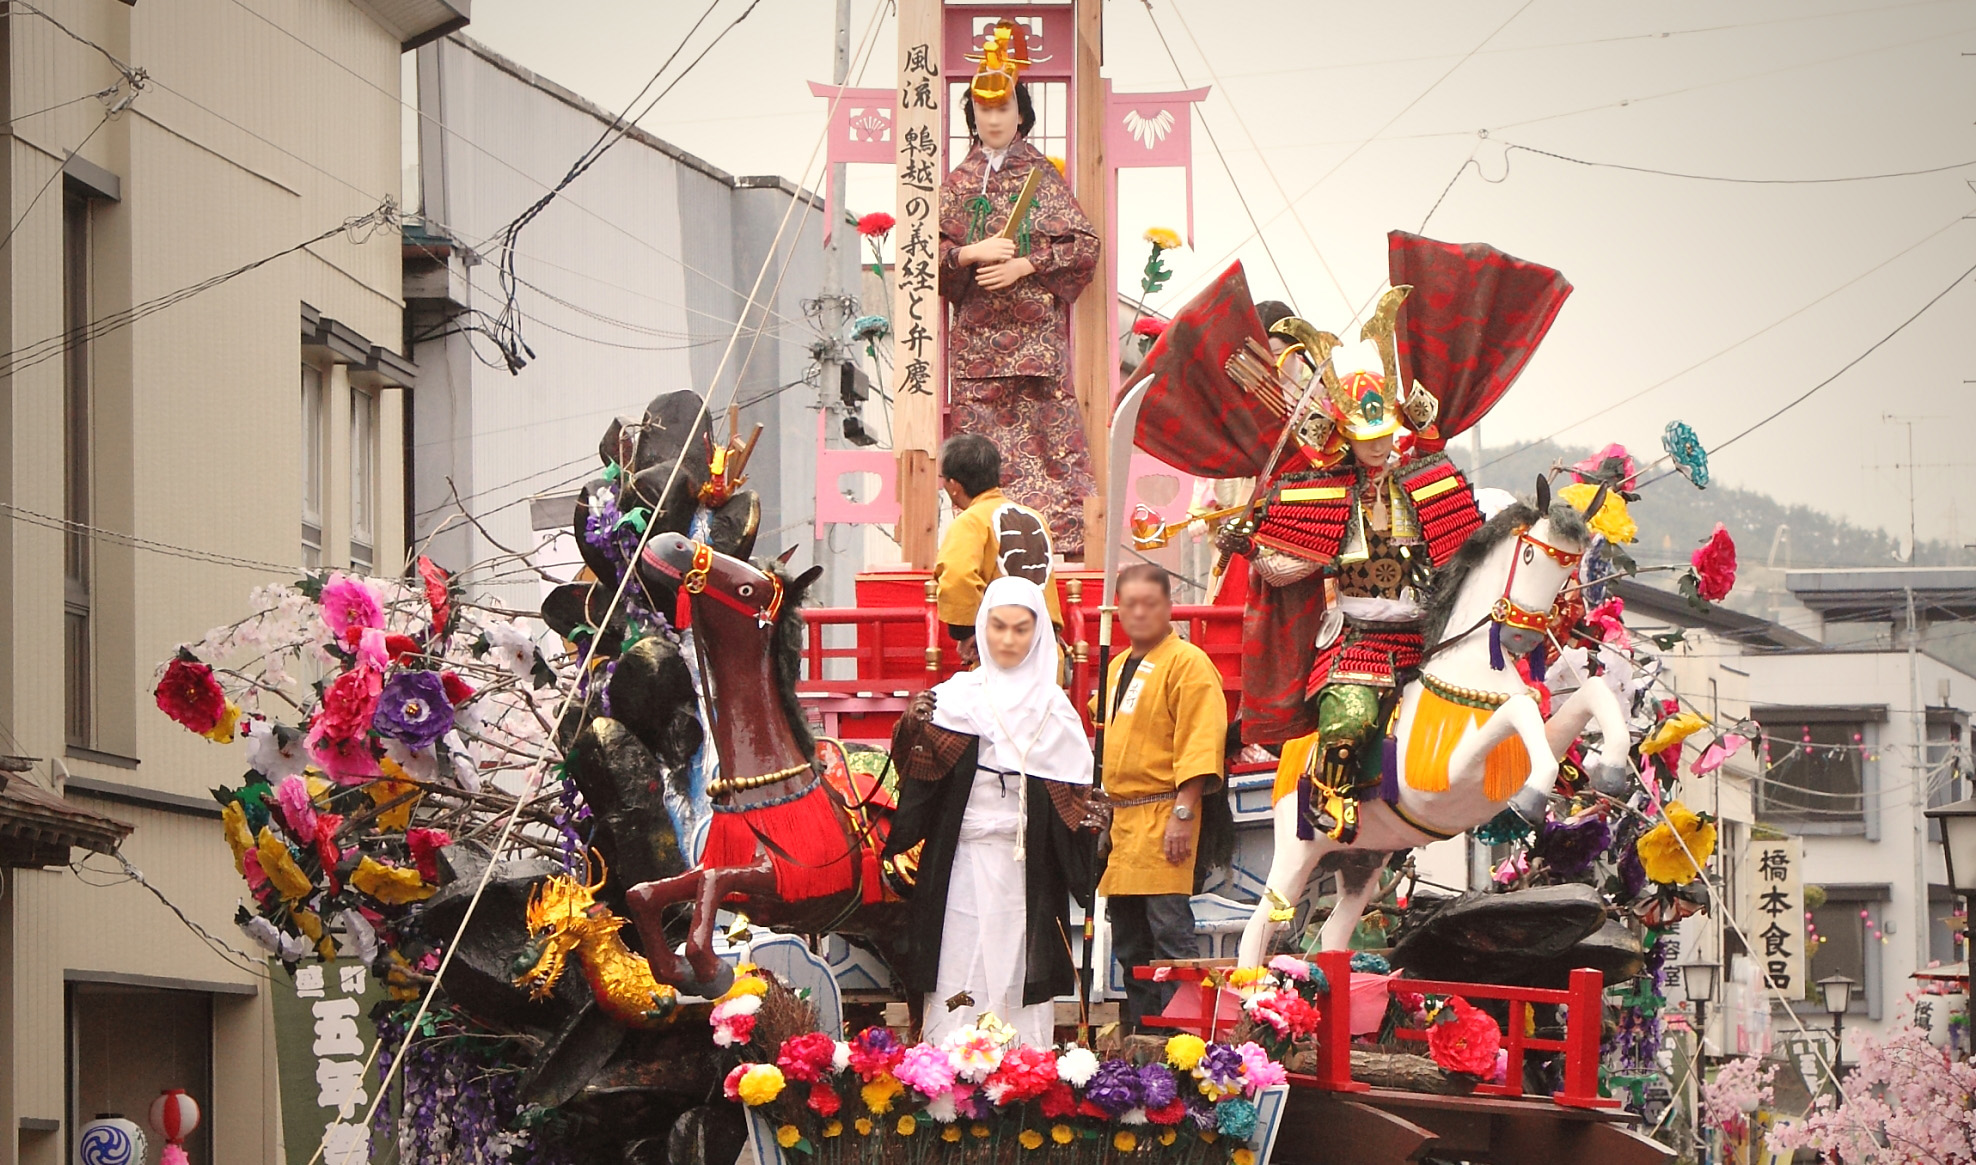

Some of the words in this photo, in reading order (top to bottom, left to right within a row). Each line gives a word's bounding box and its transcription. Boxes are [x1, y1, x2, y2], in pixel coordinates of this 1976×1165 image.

[903, 43, 939, 110] 風流
[1758, 849, 1793, 990] 橋本食品
